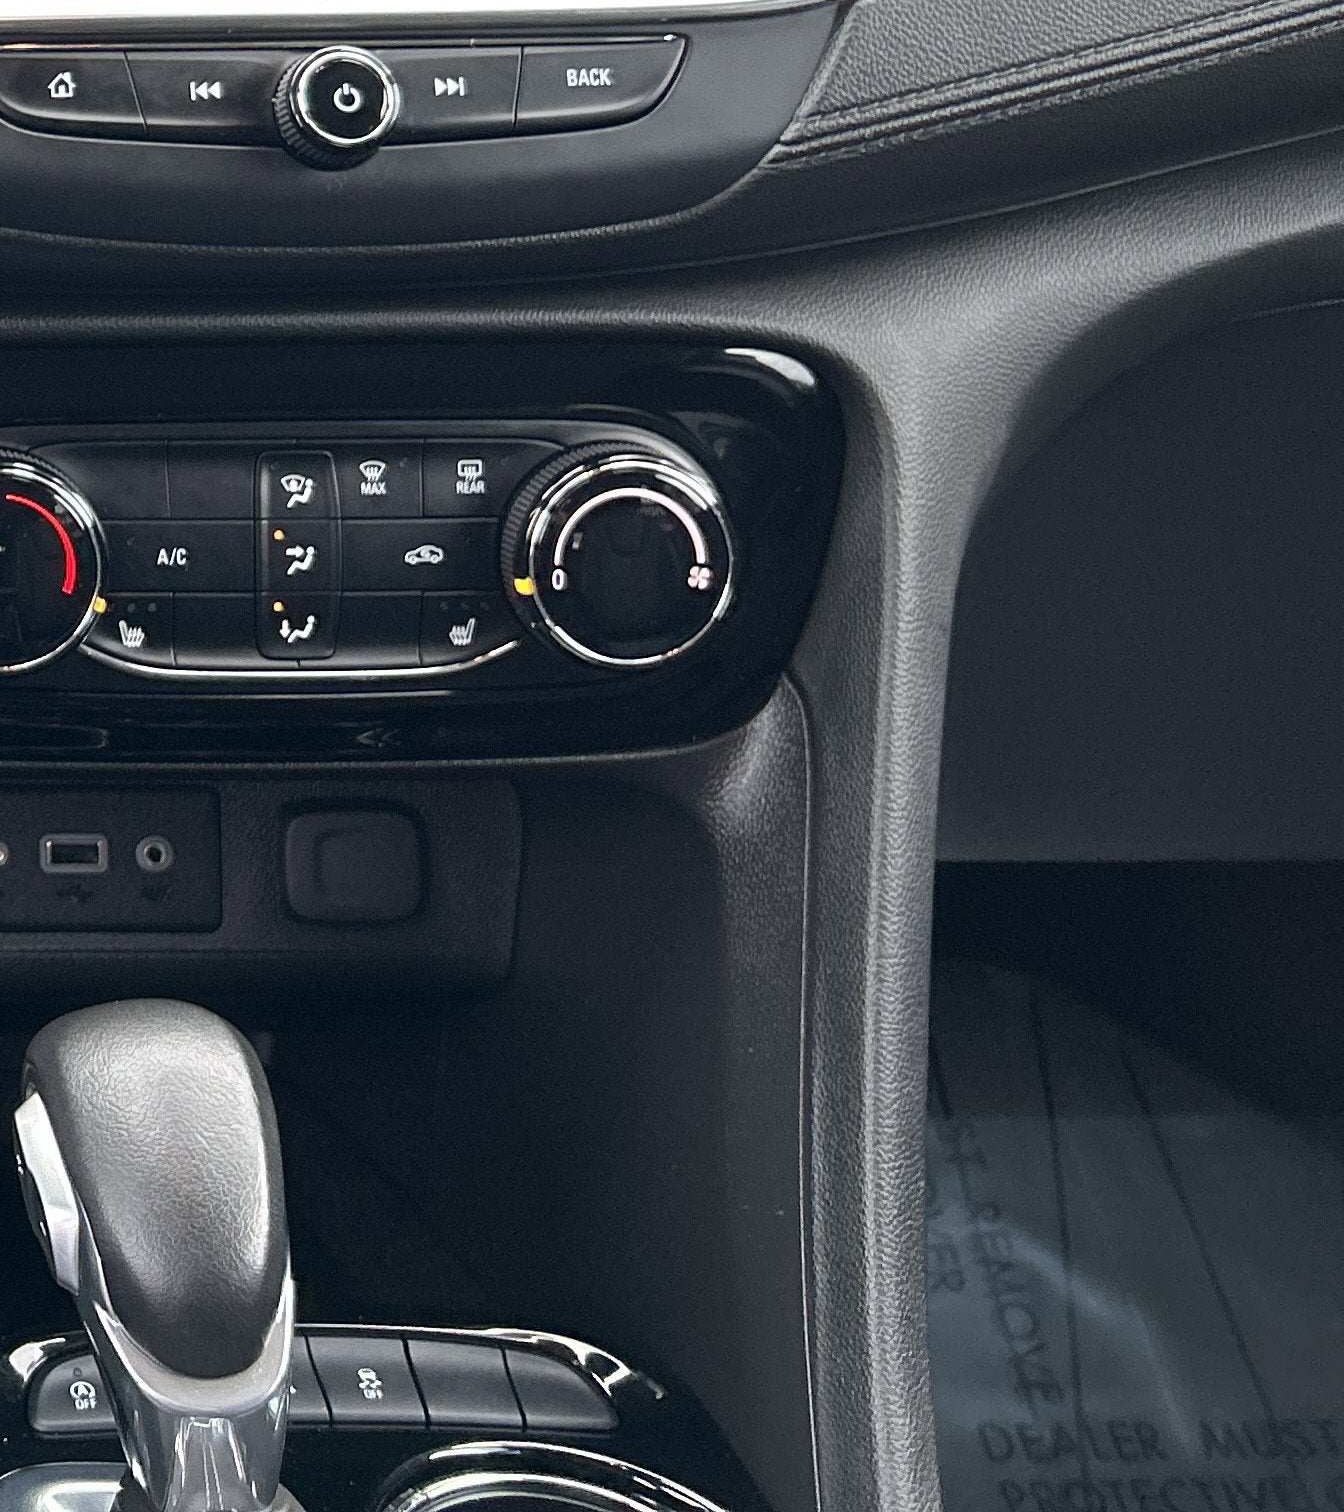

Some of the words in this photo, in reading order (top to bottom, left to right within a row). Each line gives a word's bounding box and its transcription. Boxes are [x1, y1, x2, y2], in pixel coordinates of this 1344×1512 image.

[566, 67, 612, 87] BACK
[360, 482, 387, 496] MAX
[456, 480, 485, 495] REAR
[157, 547, 187, 567] A/C
[363, 1388, 384, 1400] OFF
[75, 1398, 98, 1411] OFF
[979, 1419, 1169, 1467] DEALER
[1199, 1418, 1343, 1464] MUST
